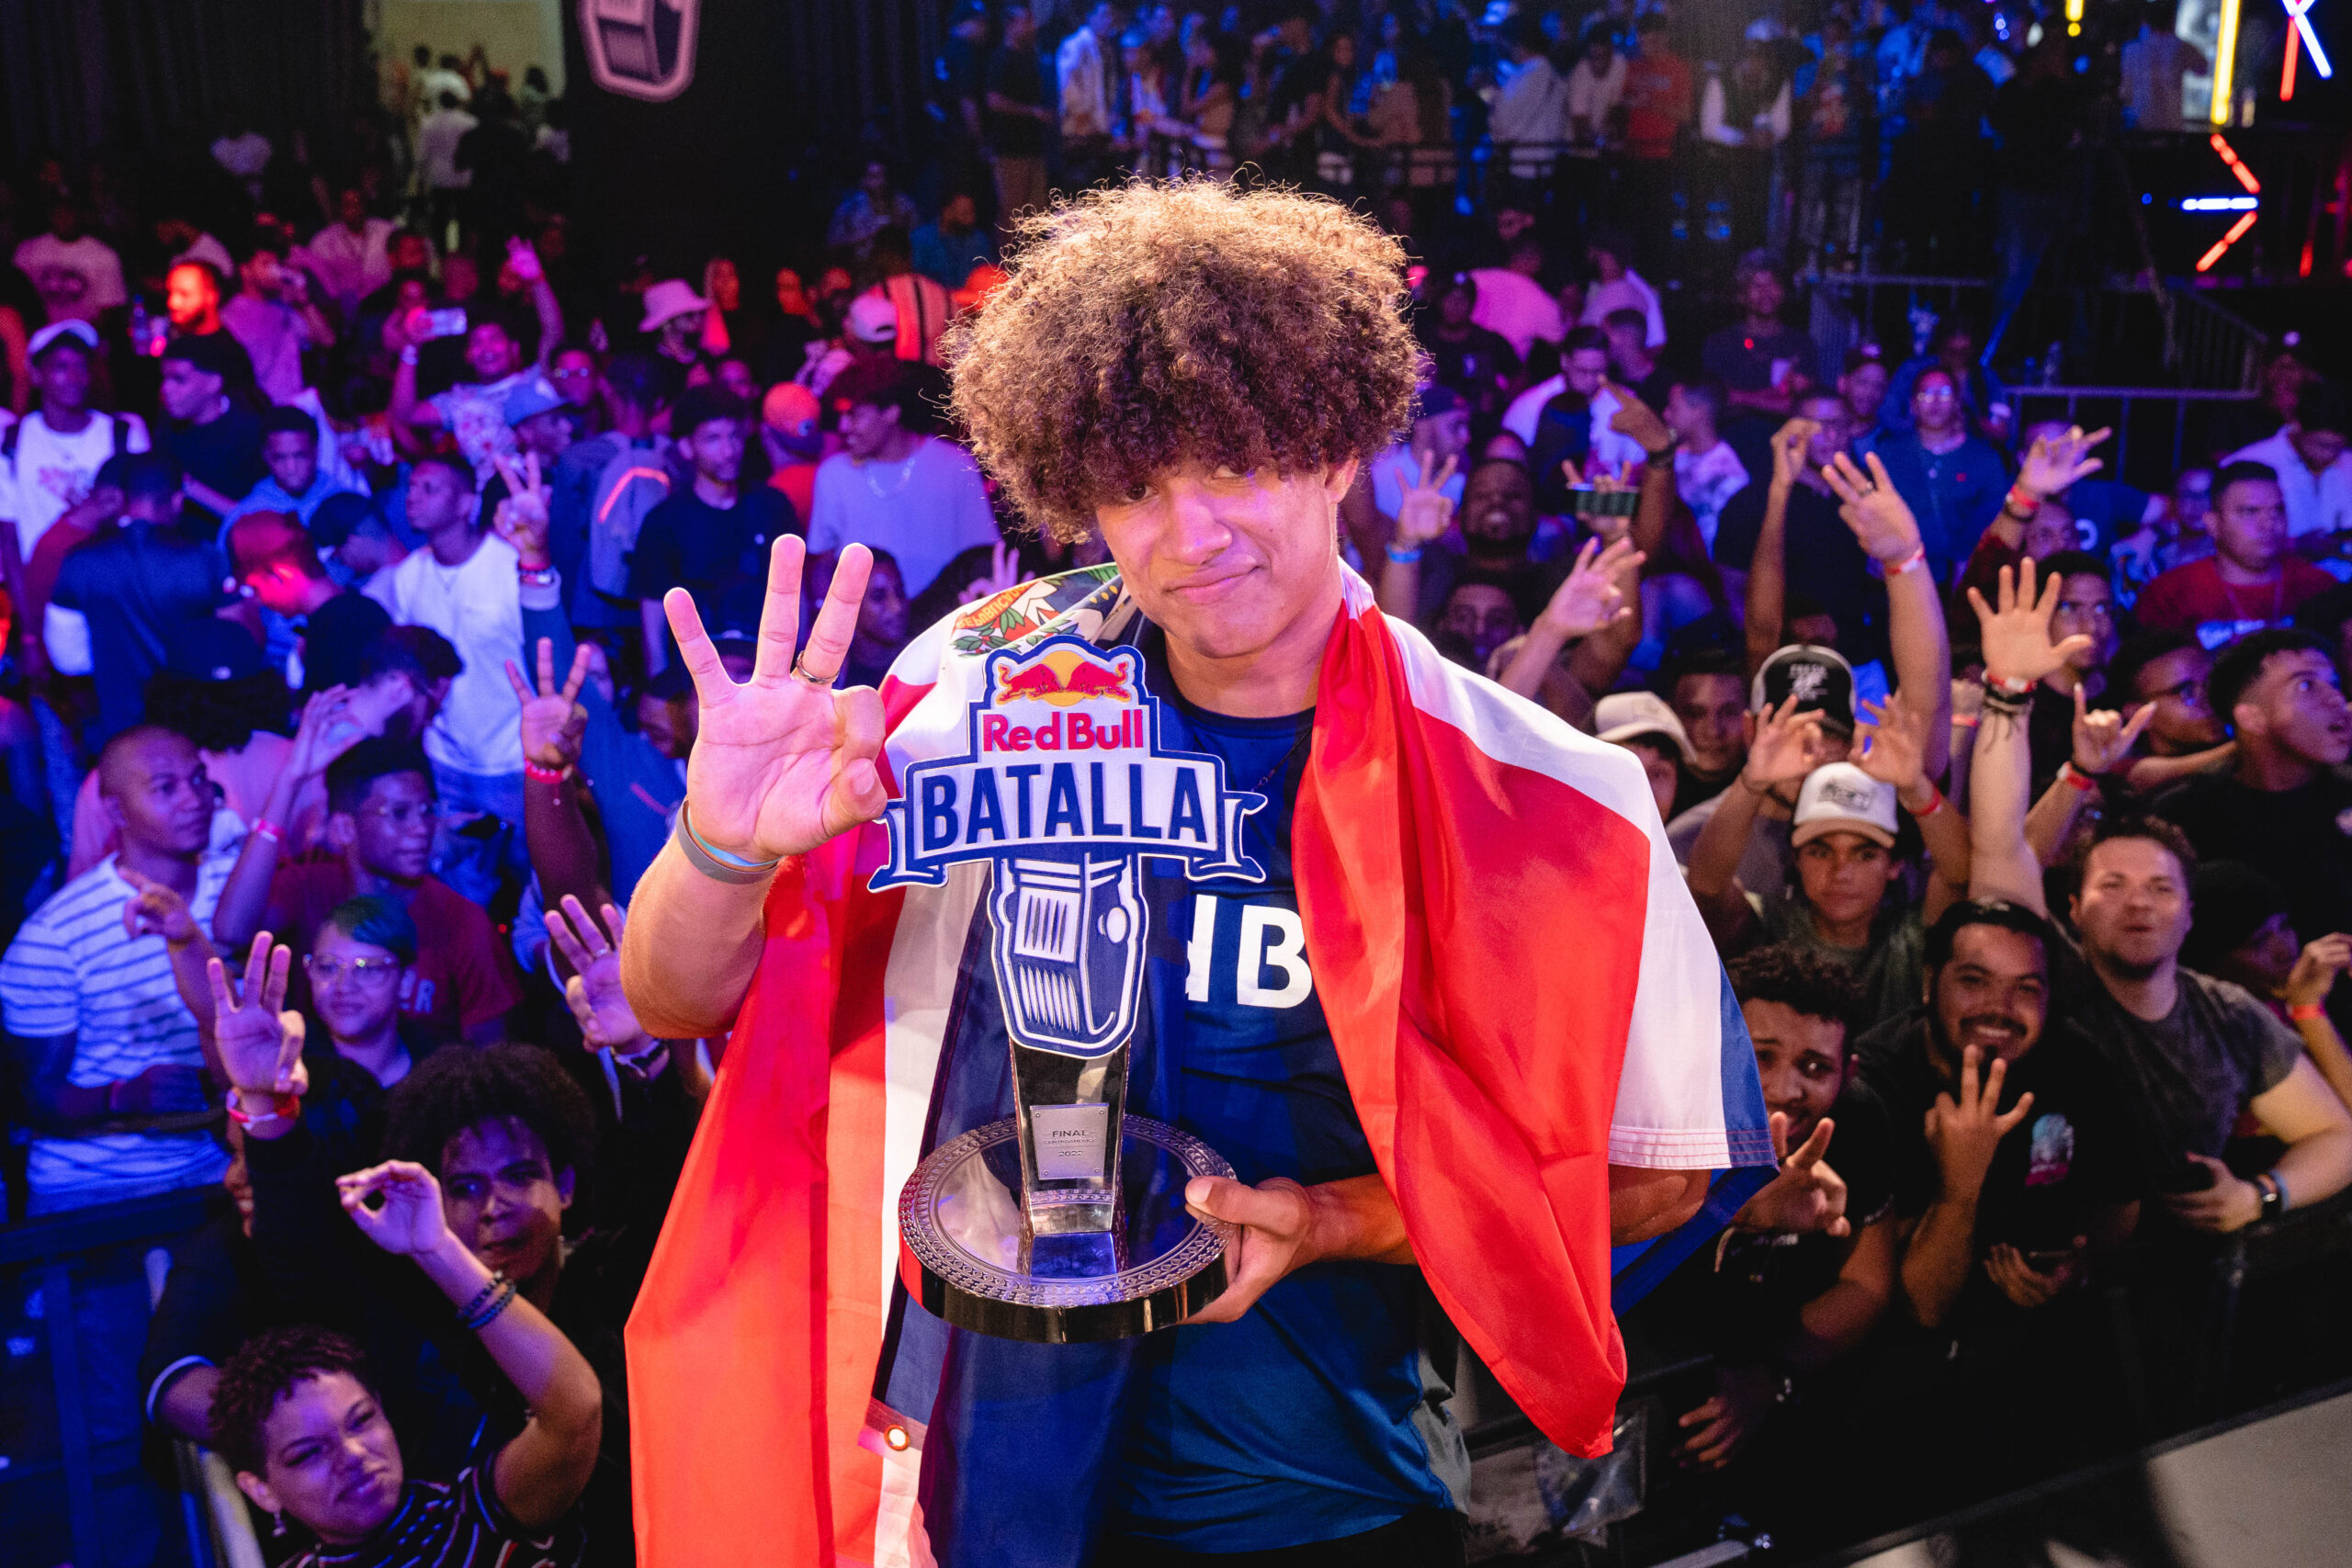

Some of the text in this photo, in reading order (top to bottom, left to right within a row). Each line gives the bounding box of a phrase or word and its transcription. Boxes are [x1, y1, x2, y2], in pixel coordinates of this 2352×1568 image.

[982, 708, 1144, 752] Red Bull
[922, 761, 1208, 852] BATALLA
